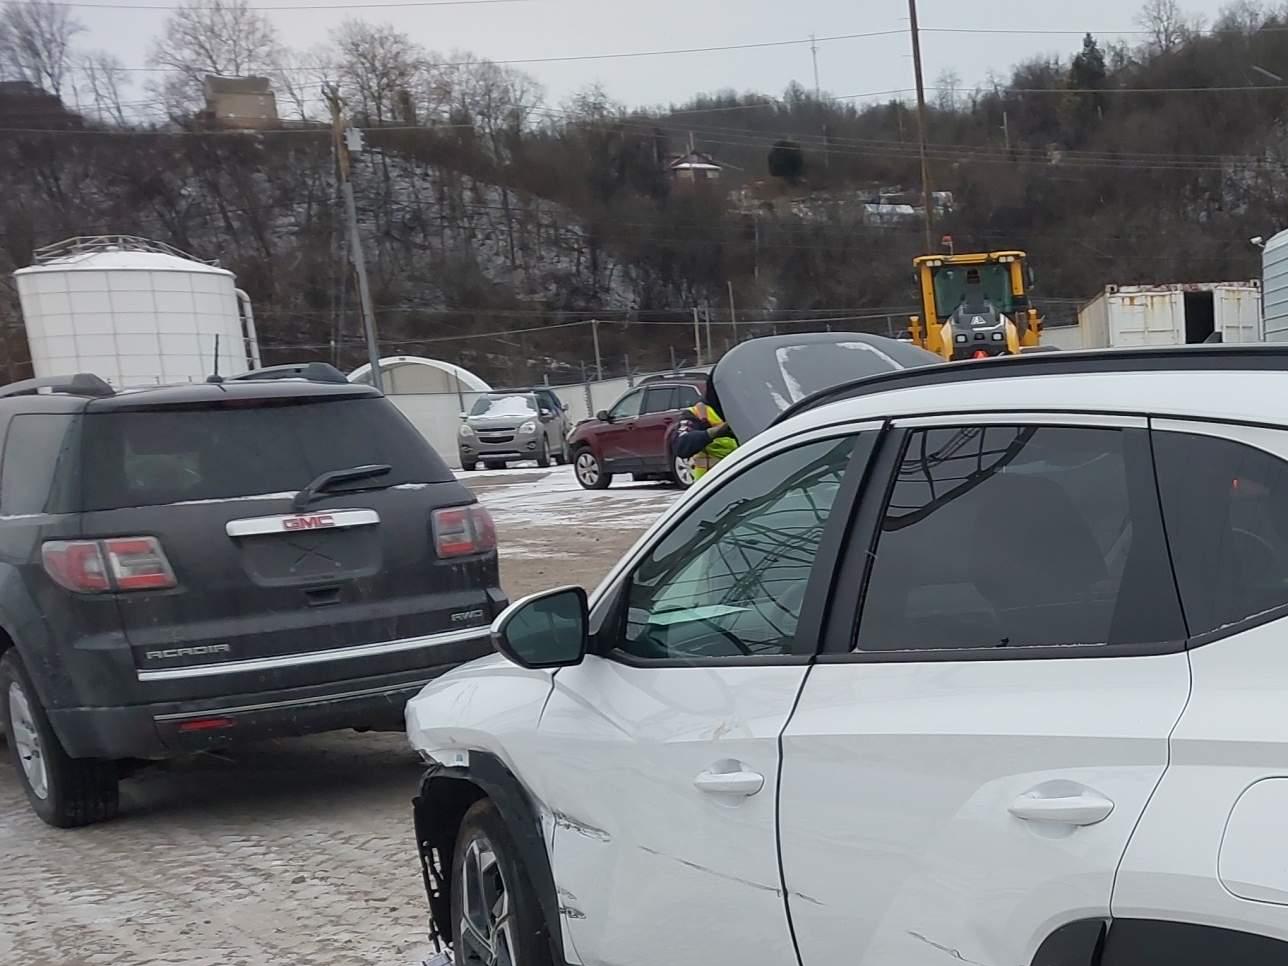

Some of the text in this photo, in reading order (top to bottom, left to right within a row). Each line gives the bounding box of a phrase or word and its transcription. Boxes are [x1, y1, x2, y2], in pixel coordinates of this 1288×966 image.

[282, 515, 335, 531] GMC
[451, 609, 484, 622] AWD
[145, 643, 230, 660] ACADIA
